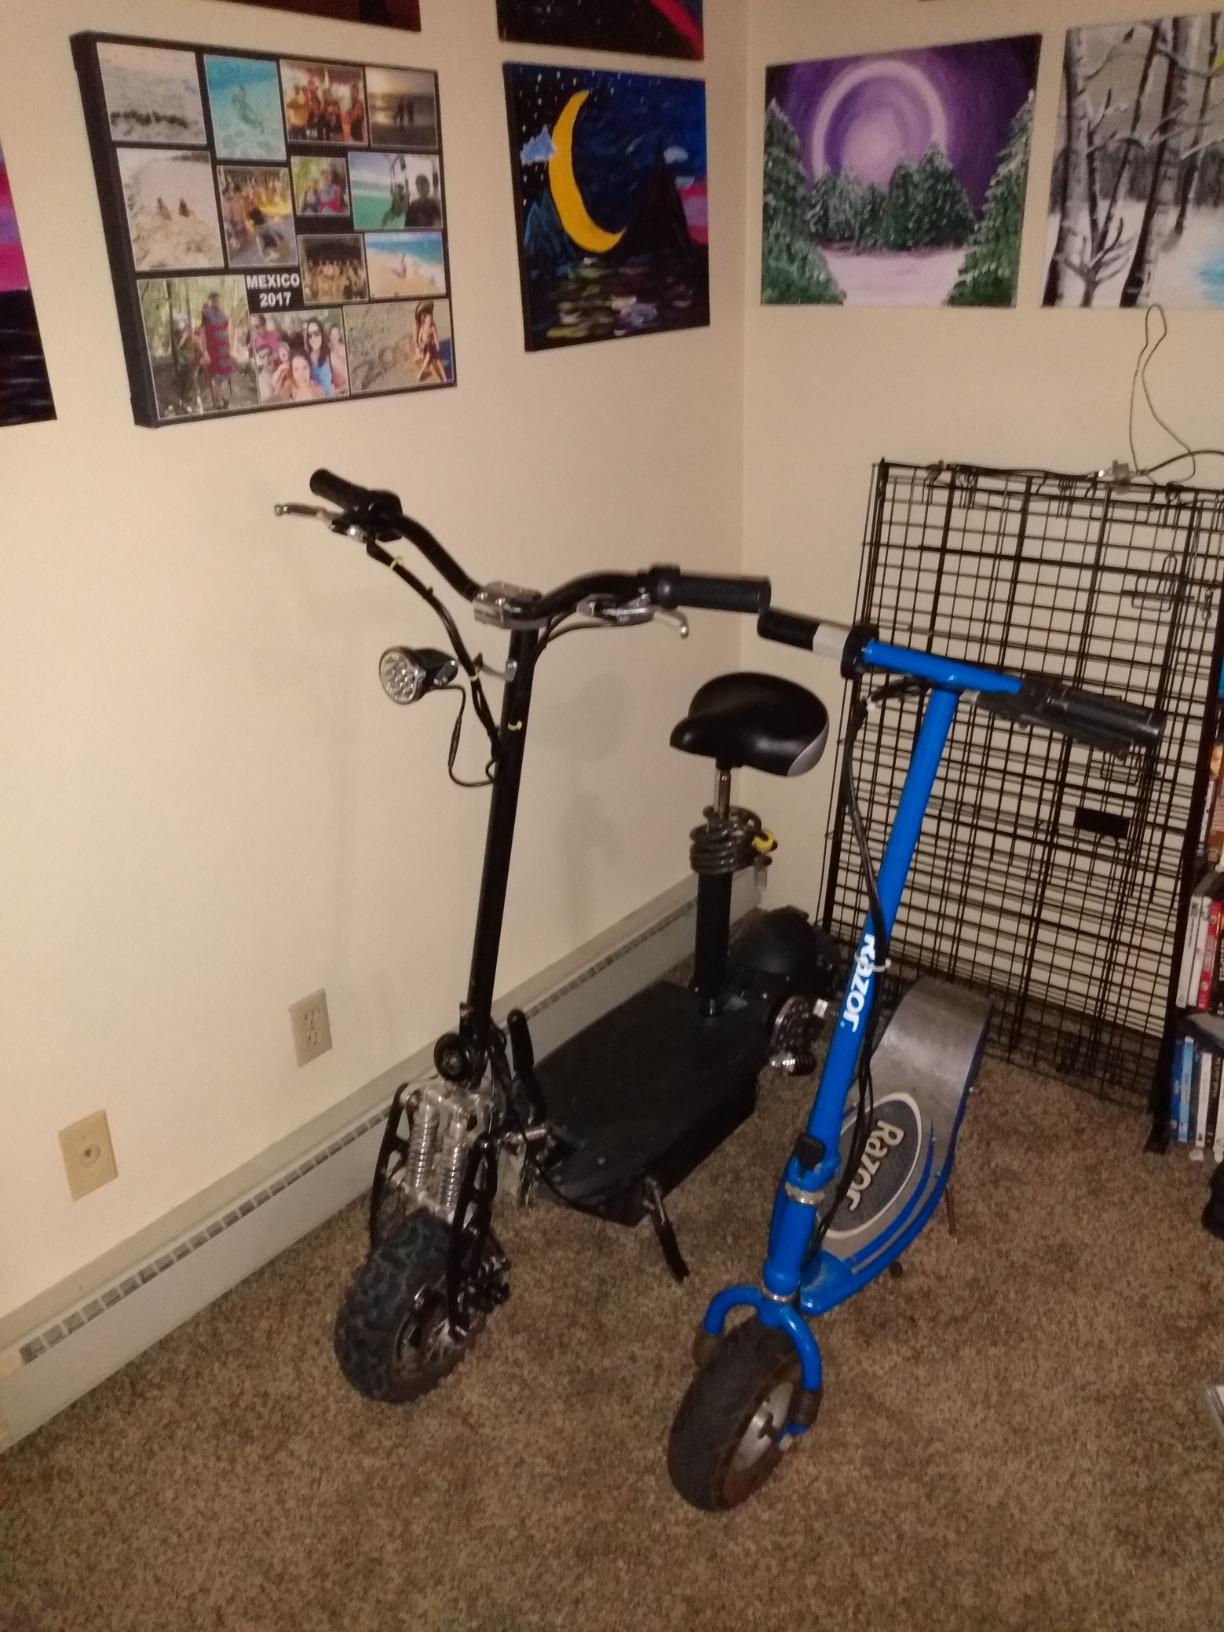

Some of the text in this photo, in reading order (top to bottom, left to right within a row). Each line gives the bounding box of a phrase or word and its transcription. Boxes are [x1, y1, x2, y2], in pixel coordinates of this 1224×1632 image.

[246, 273, 300, 290] MEXICO
[259, 291, 291, 308] 2017
[846, 1120, 904, 1211] Razor
